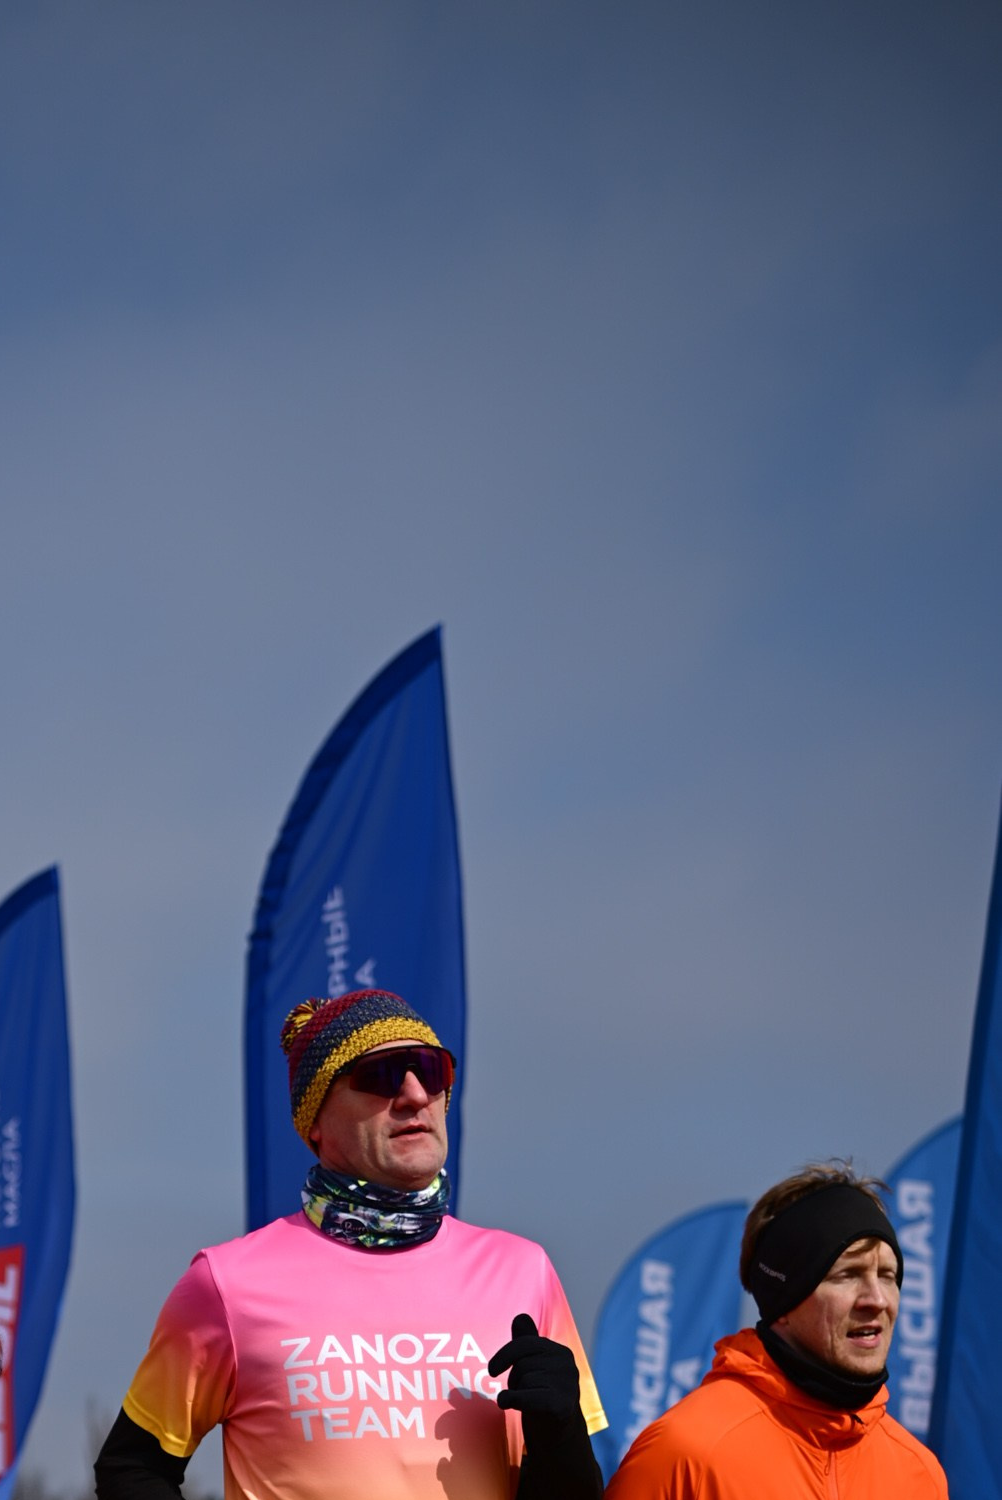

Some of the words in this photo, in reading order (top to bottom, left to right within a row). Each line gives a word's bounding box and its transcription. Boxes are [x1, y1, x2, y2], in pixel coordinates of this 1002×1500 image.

[321, 886, 349, 1000] РНЫЕ
[2, 1118, 21, 1227] МАСЛА
[899, 1179, 936, 1434] ВЫСШАЯ
[280, 1333, 488, 1371] ZANOZA
[286, 1368, 502, 1406] RUNNING
[290, 1406, 426, 1442] TEAM
